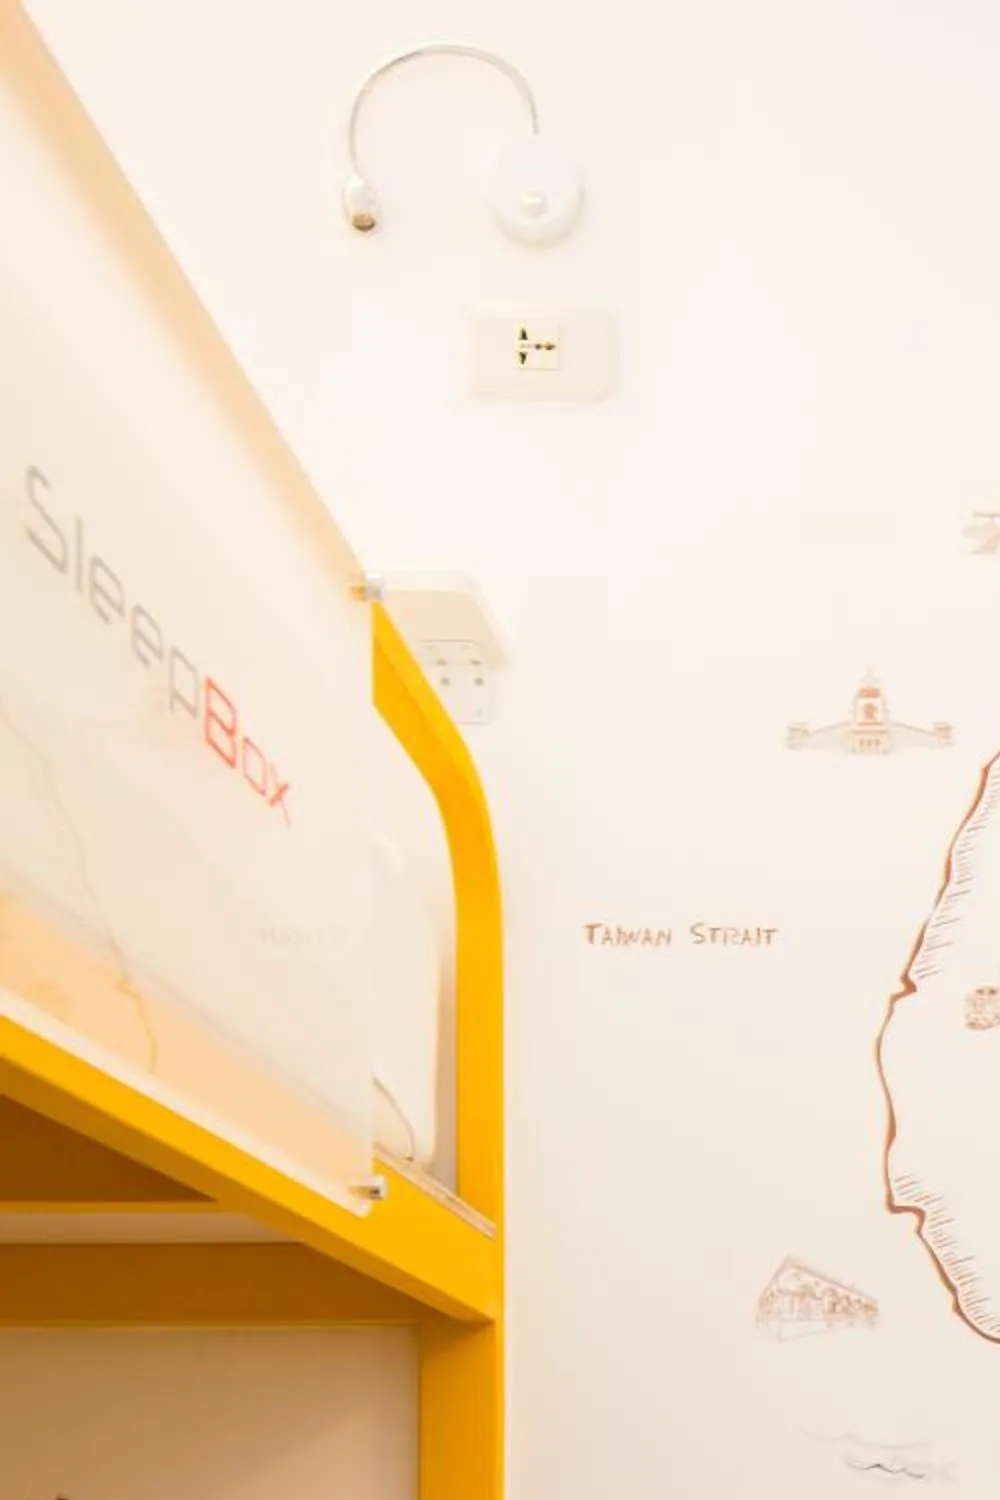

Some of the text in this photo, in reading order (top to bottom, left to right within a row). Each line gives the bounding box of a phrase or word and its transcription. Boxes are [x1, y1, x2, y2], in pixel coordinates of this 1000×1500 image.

[25, 465, 292, 829] SleepBox
[583, 920, 779, 947] TAIWAN STRAIT
